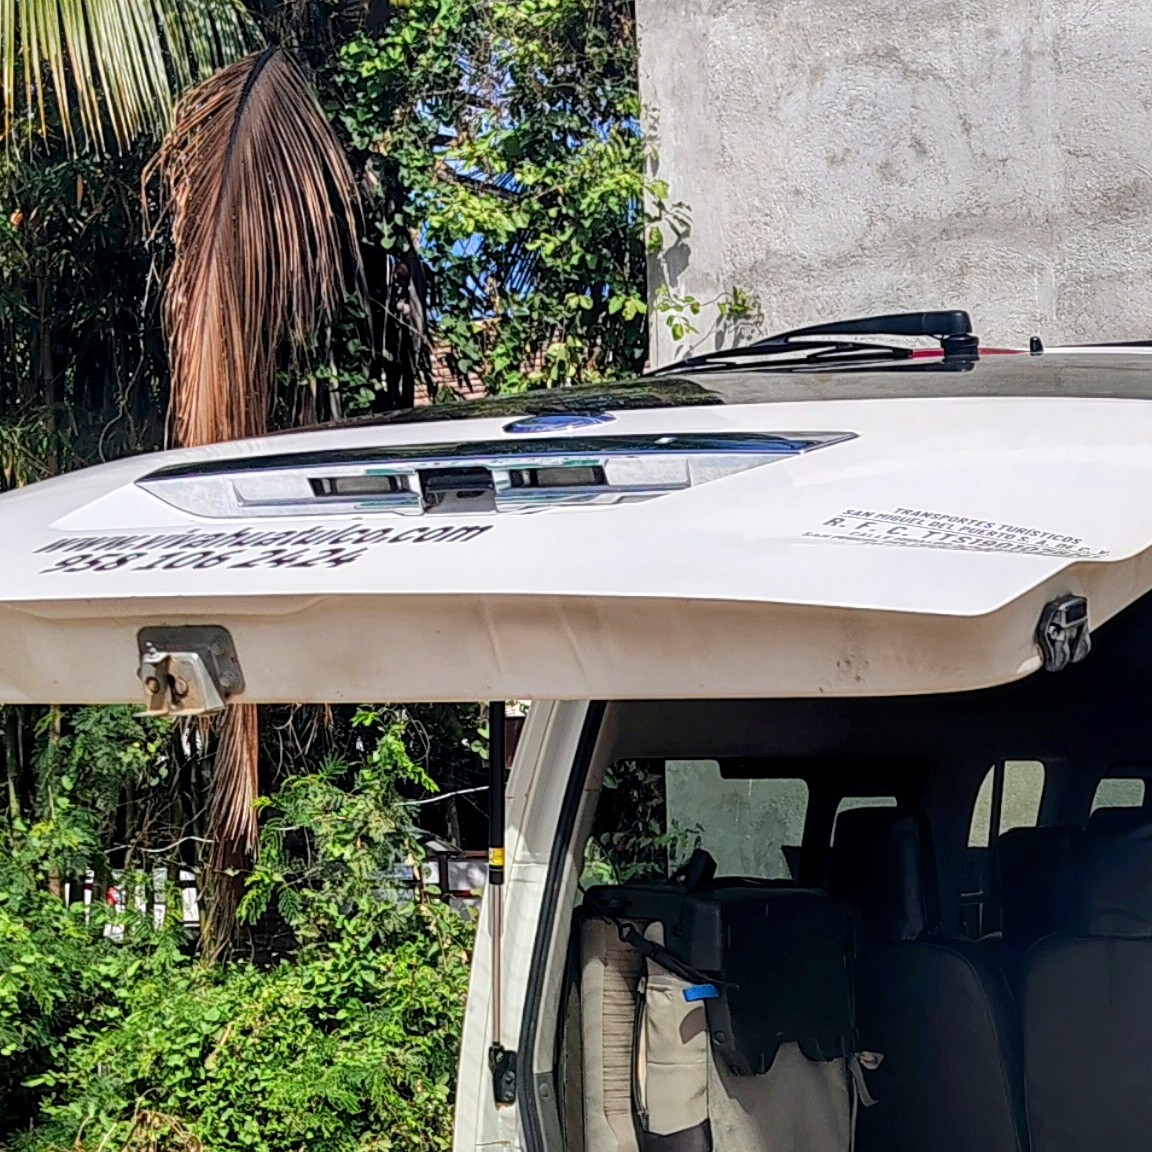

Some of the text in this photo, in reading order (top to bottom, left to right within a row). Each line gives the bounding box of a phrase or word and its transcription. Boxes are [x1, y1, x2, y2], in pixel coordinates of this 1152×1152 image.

[32, 523, 495, 554] www.vivahuatulco.com
[822, 517, 846, 528] R.
[855, 521, 878, 532] F.
[886, 526, 908, 537] C.
[842, 509, 876, 518] SAN
[874, 513, 926, 526] MIGUEL
[928, 520, 956, 531] DEL
[958, 526, 1017, 540] PUERTO
[893, 507, 1083, 545] TRANSPORTES TURÍSTICOS
[38, 547, 369, 574] 958 106 2424
